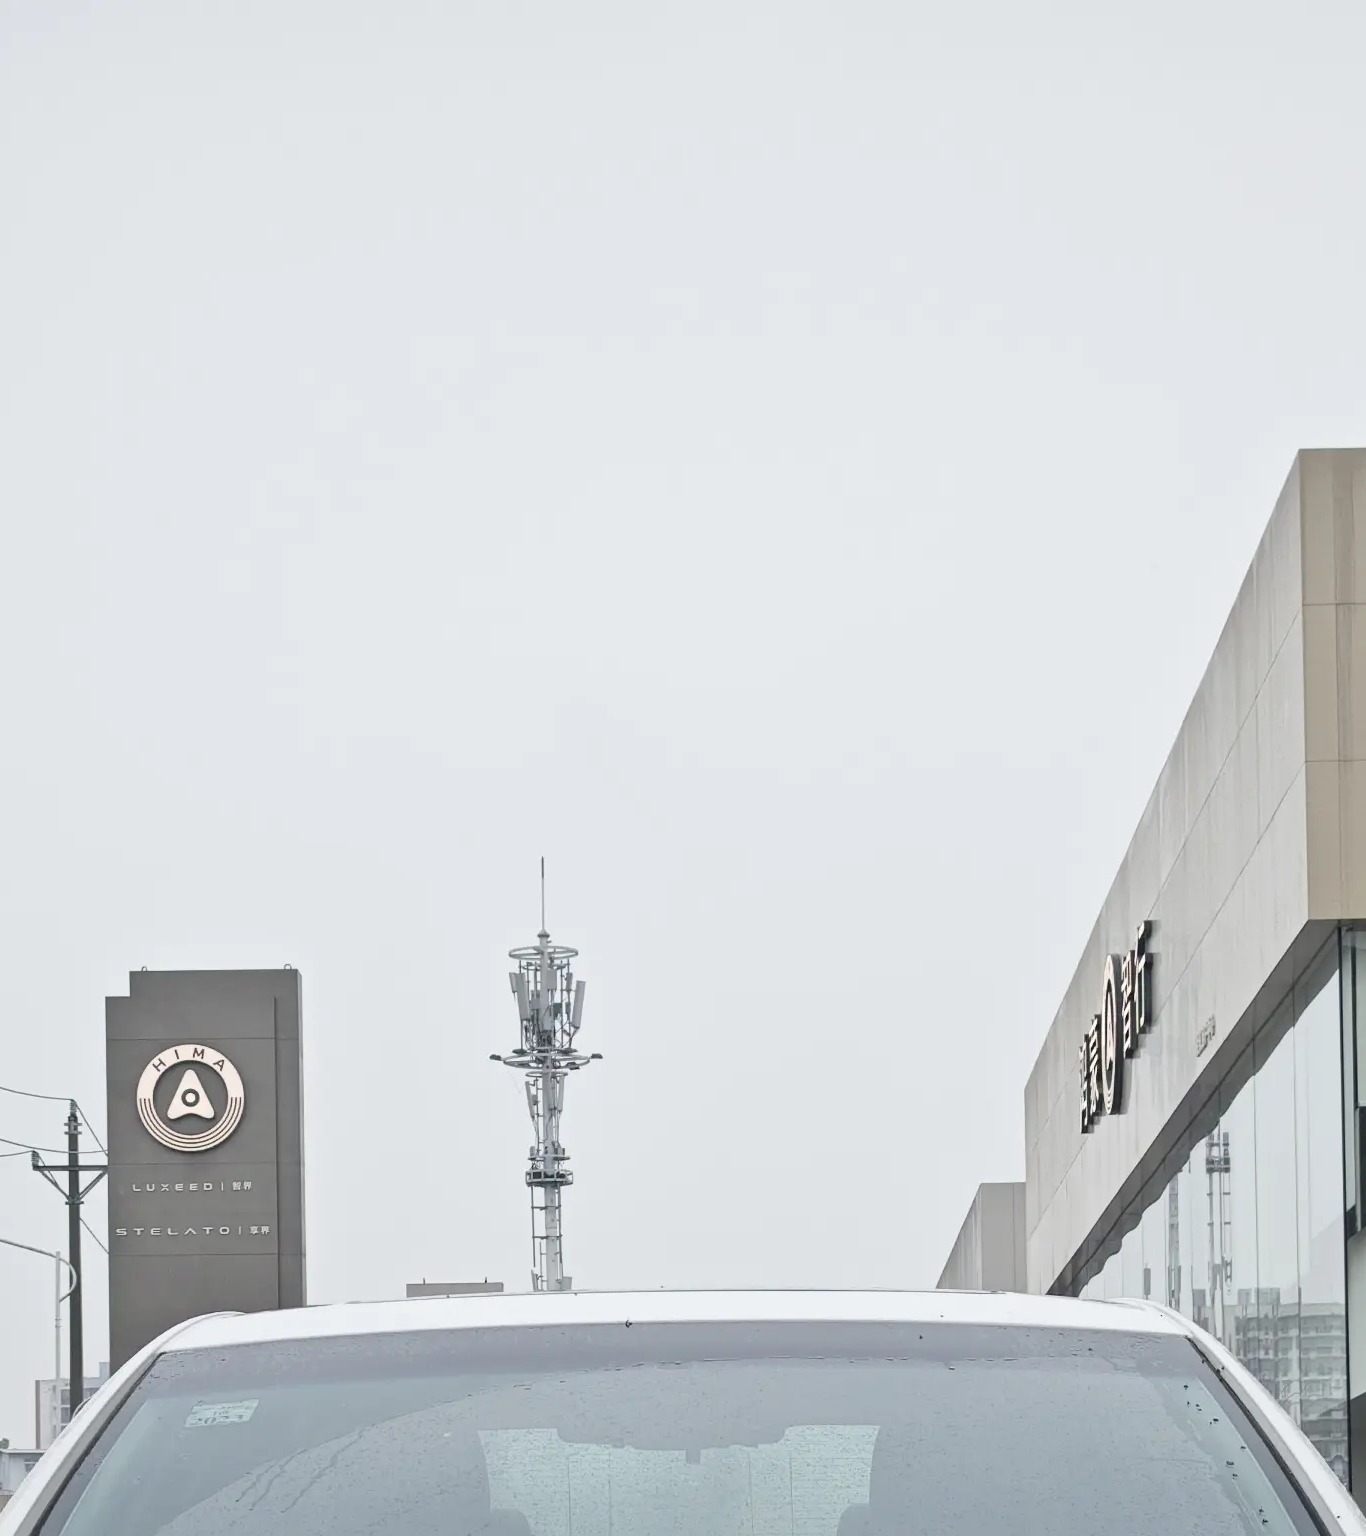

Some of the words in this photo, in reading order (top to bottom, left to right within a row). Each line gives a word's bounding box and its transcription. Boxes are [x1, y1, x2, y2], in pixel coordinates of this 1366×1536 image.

[152, 1047, 225, 1072] HIMA
[132, 1182, 213, 1192] LUXEED
[115, 1226, 231, 1236] STELATO
